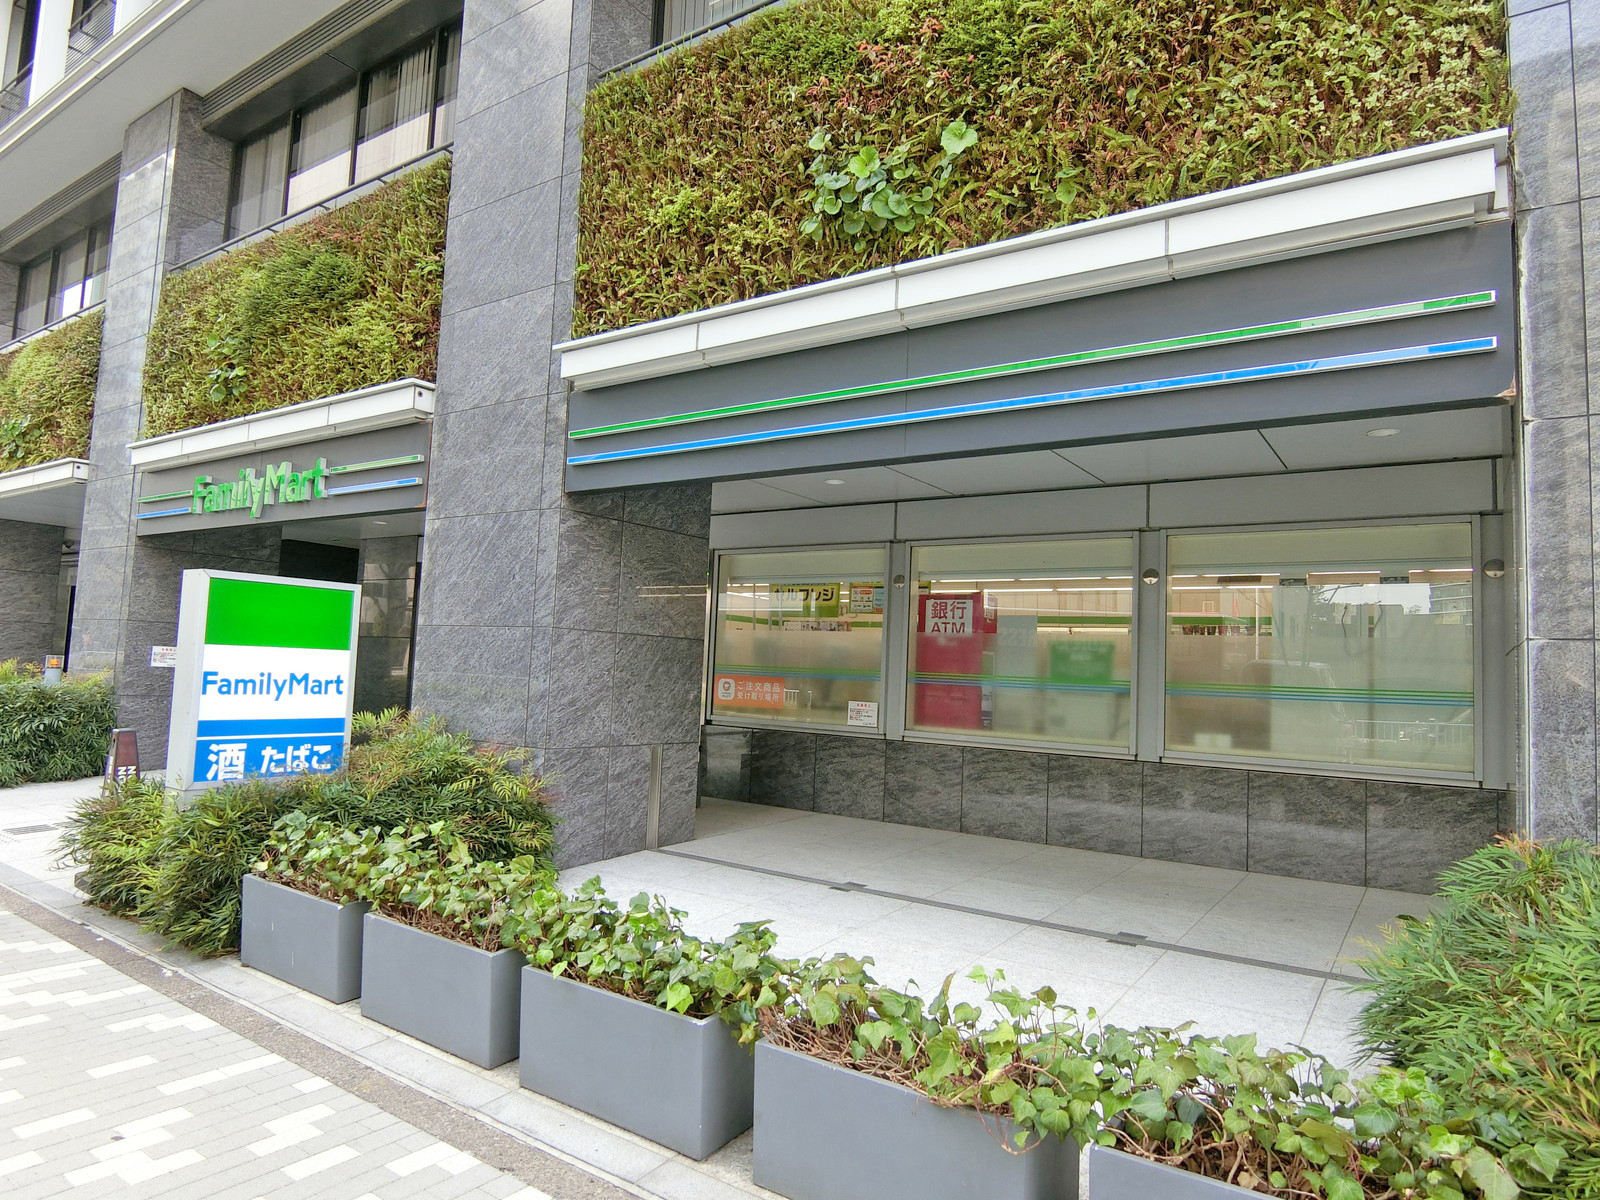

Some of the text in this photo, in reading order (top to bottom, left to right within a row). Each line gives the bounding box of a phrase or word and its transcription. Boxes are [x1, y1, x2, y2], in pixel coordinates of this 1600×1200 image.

[192, 457, 329, 518] FamilyMart
[931, 601, 967, 620] 銀行
[931, 622, 966, 633] ATM
[201, 671, 344, 701] FamilyMart
[737, 680, 780, 693] ご注文商品
[736, 691, 780, 702] 受け取り場所
[206, 743, 332, 781] 酒 たばこ
